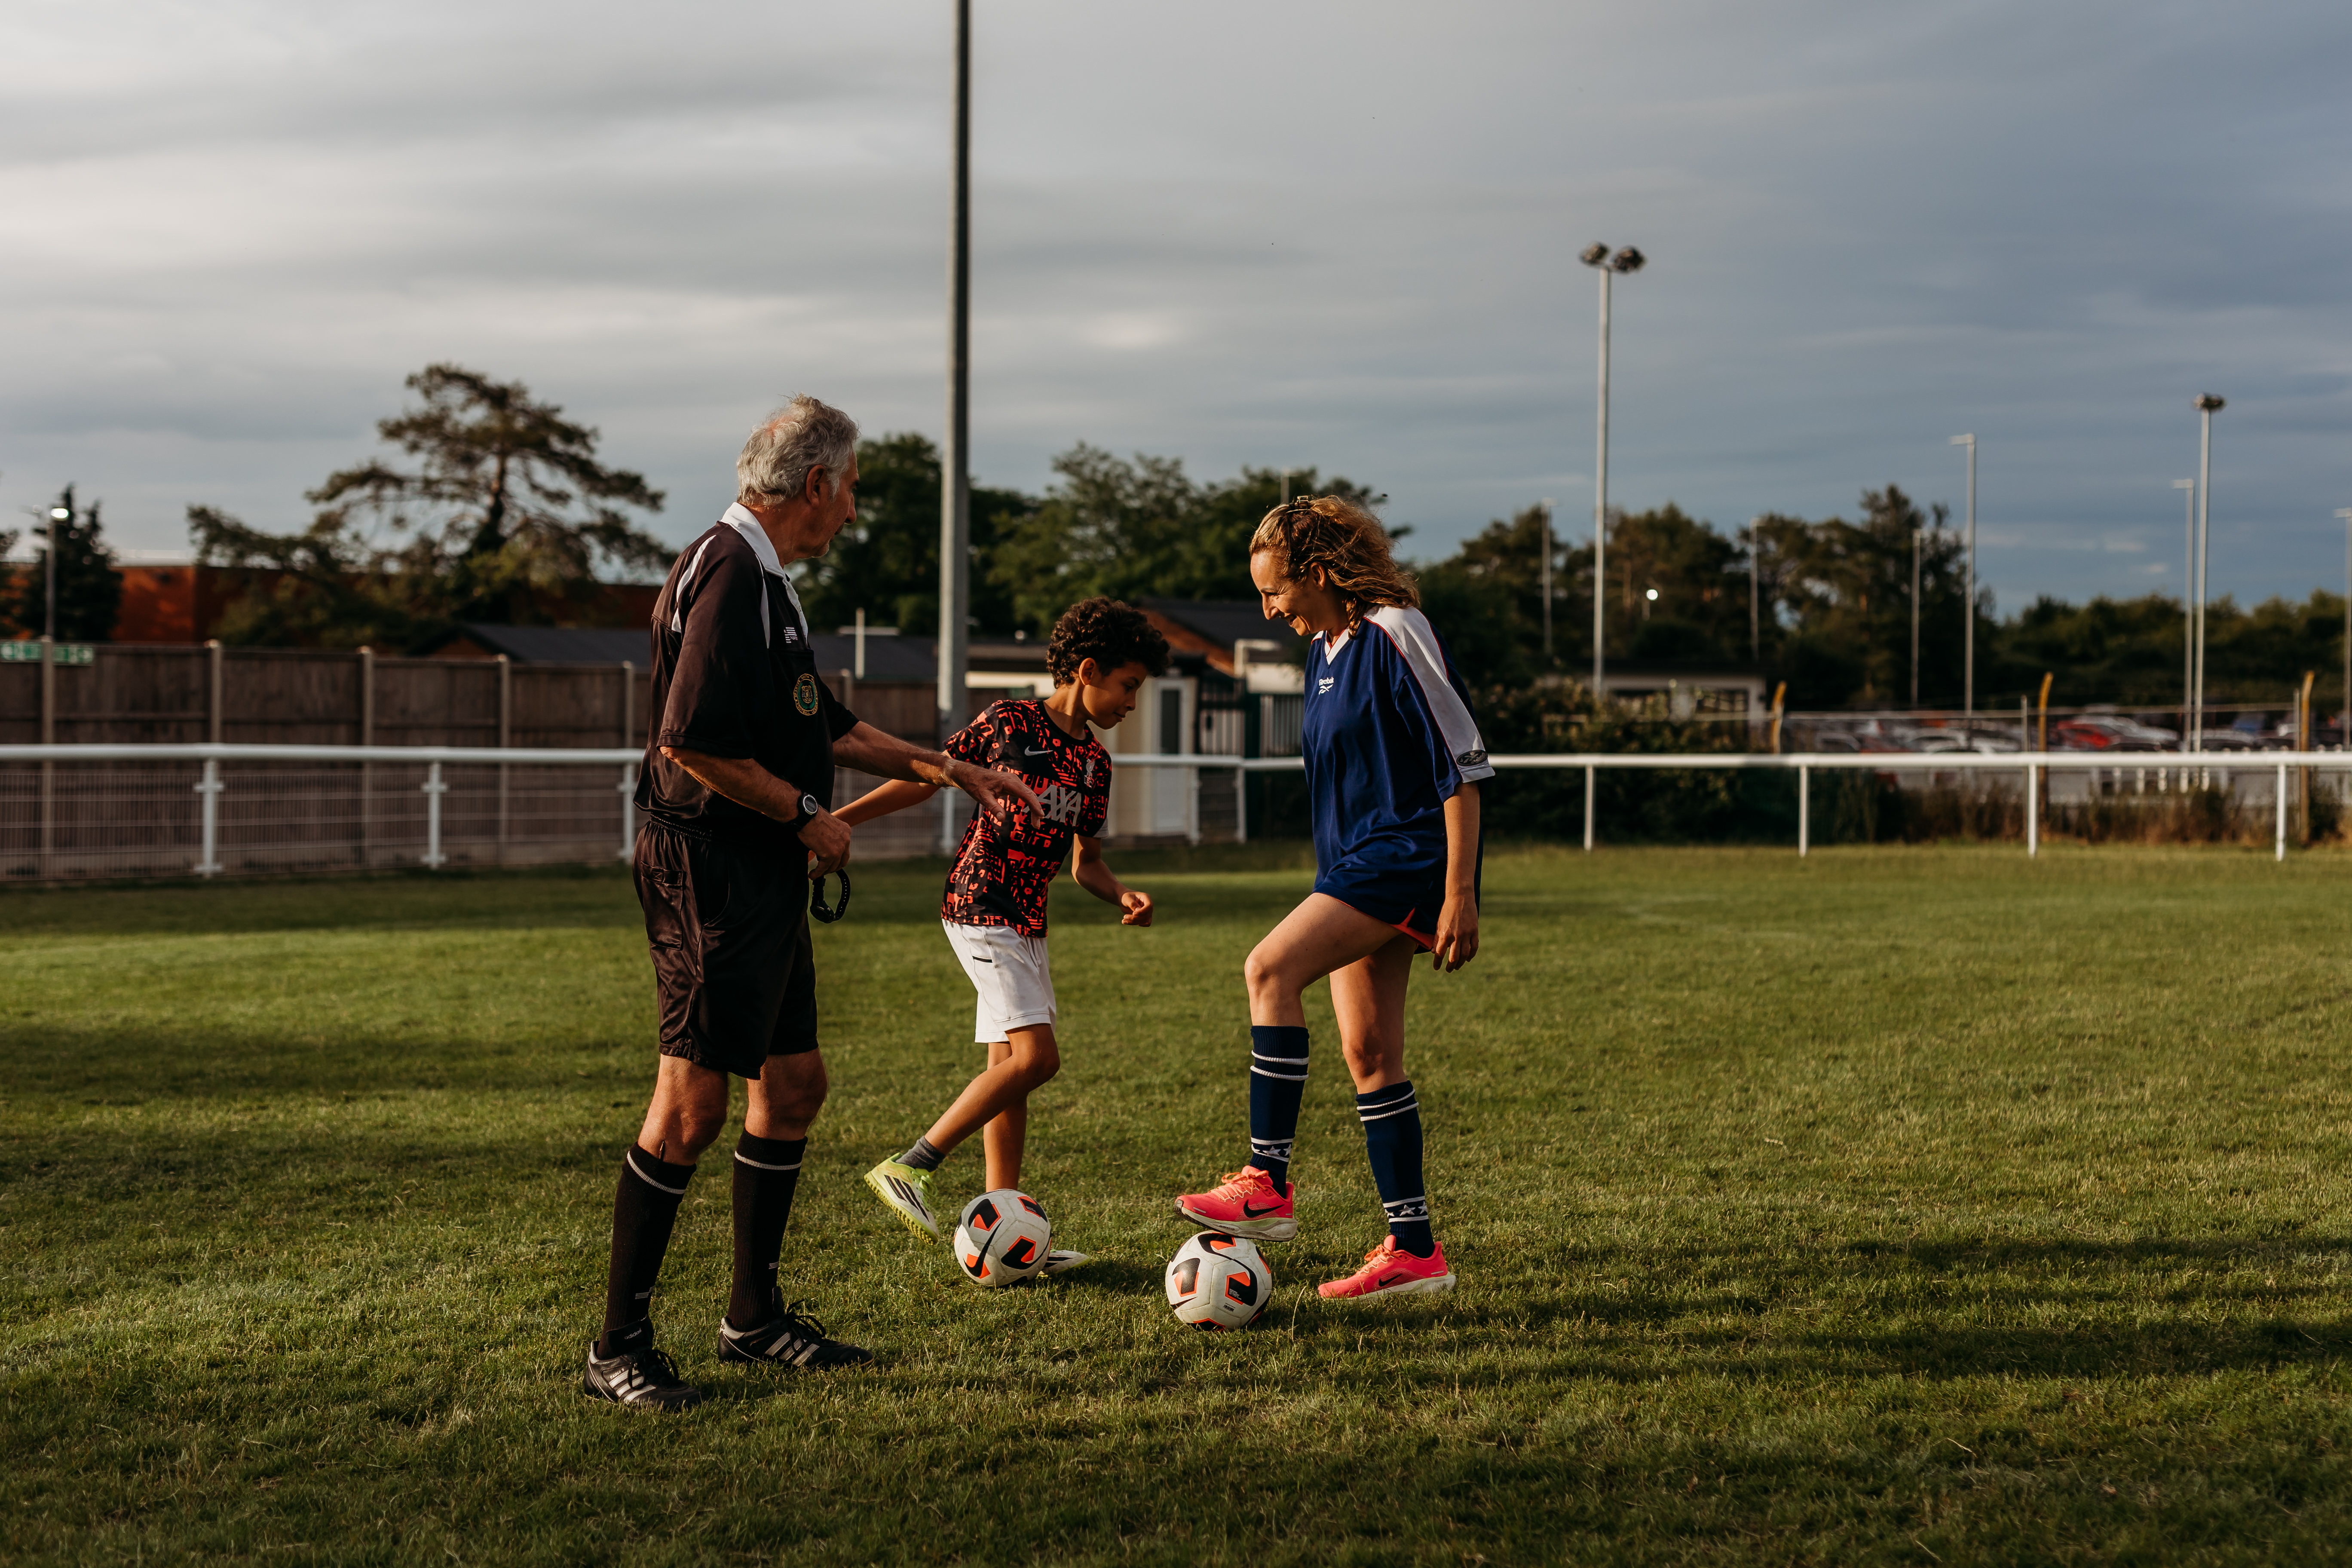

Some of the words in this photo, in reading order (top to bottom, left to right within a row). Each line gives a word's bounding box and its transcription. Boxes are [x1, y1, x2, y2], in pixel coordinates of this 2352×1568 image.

[1319, 677, 1334, 686] Reebok
[1021, 784, 1081, 826] AXA
[624, 1329, 642, 1340] adidas
